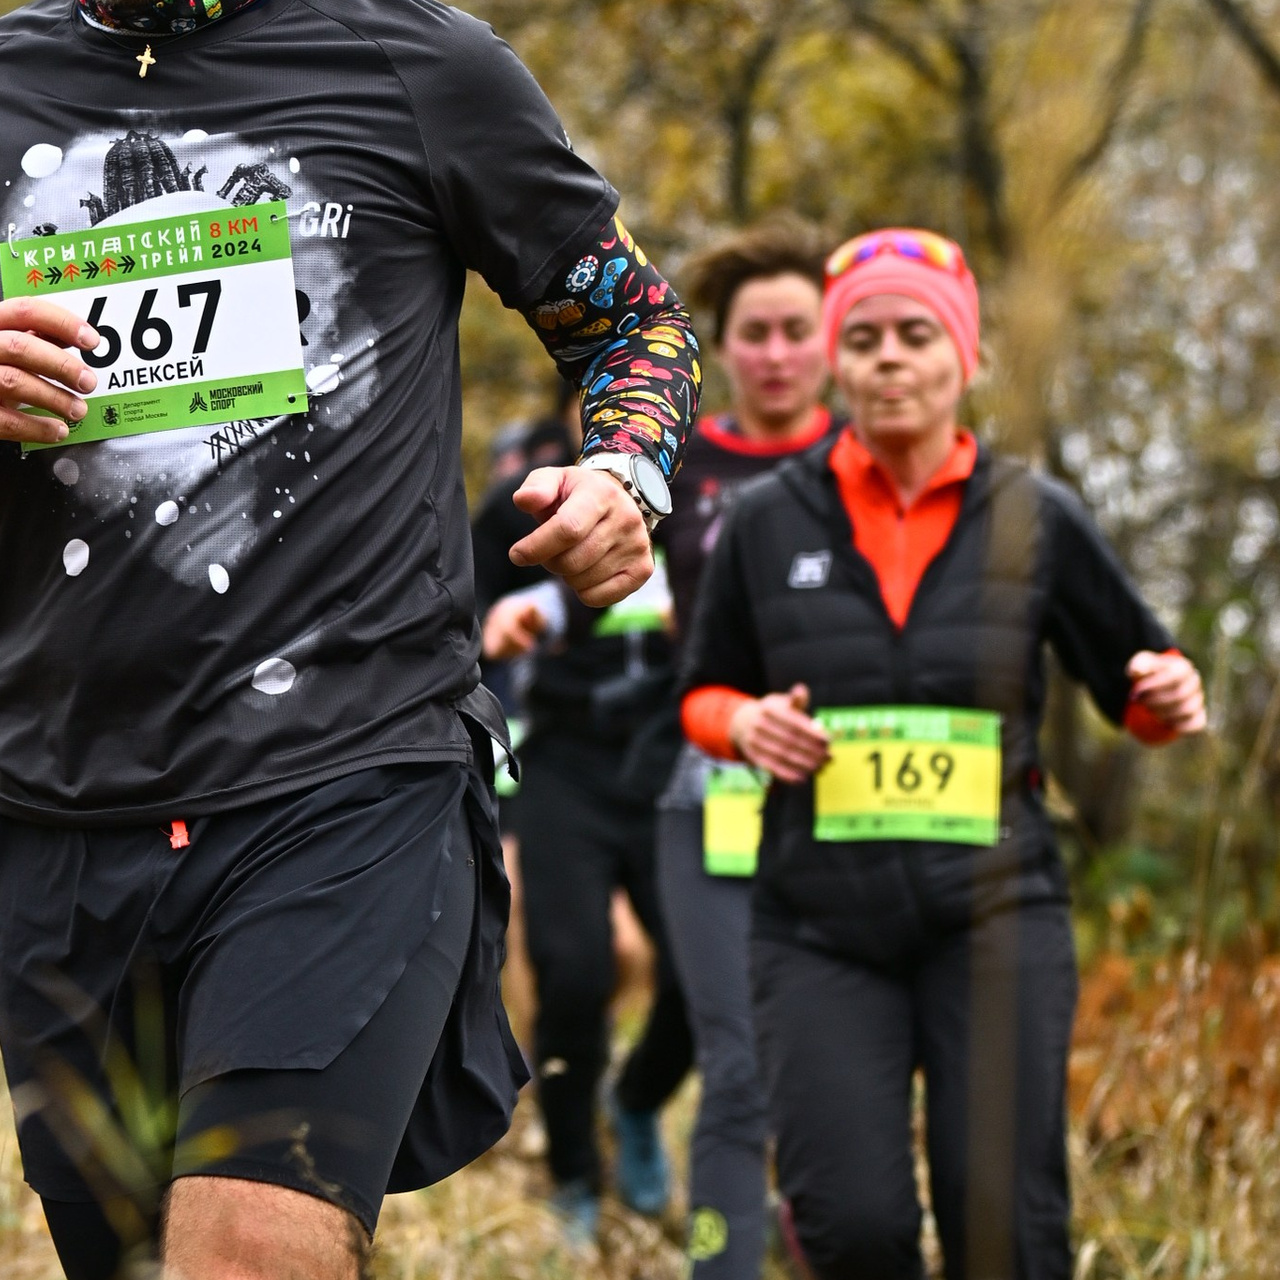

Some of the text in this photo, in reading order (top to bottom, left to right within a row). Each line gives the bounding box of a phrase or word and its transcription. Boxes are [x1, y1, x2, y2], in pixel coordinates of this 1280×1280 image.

[209, 222, 221, 238] 8
[140, 244, 203, 269] ТРЕЙЛ
[211, 238, 261, 258] 2024
[80, 279, 222, 369] 667
[107, 357, 204, 389] АЛЕКСЕЙ
[209, 381, 263, 400] МОСКОВСКИЙ
[122, 399, 161, 409] Департамент
[123, 409, 144, 418] спорта
[210, 398, 235, 411] СПОРТ
[145, 412, 168, 420] Москвы
[867, 750, 956, 793] 169
